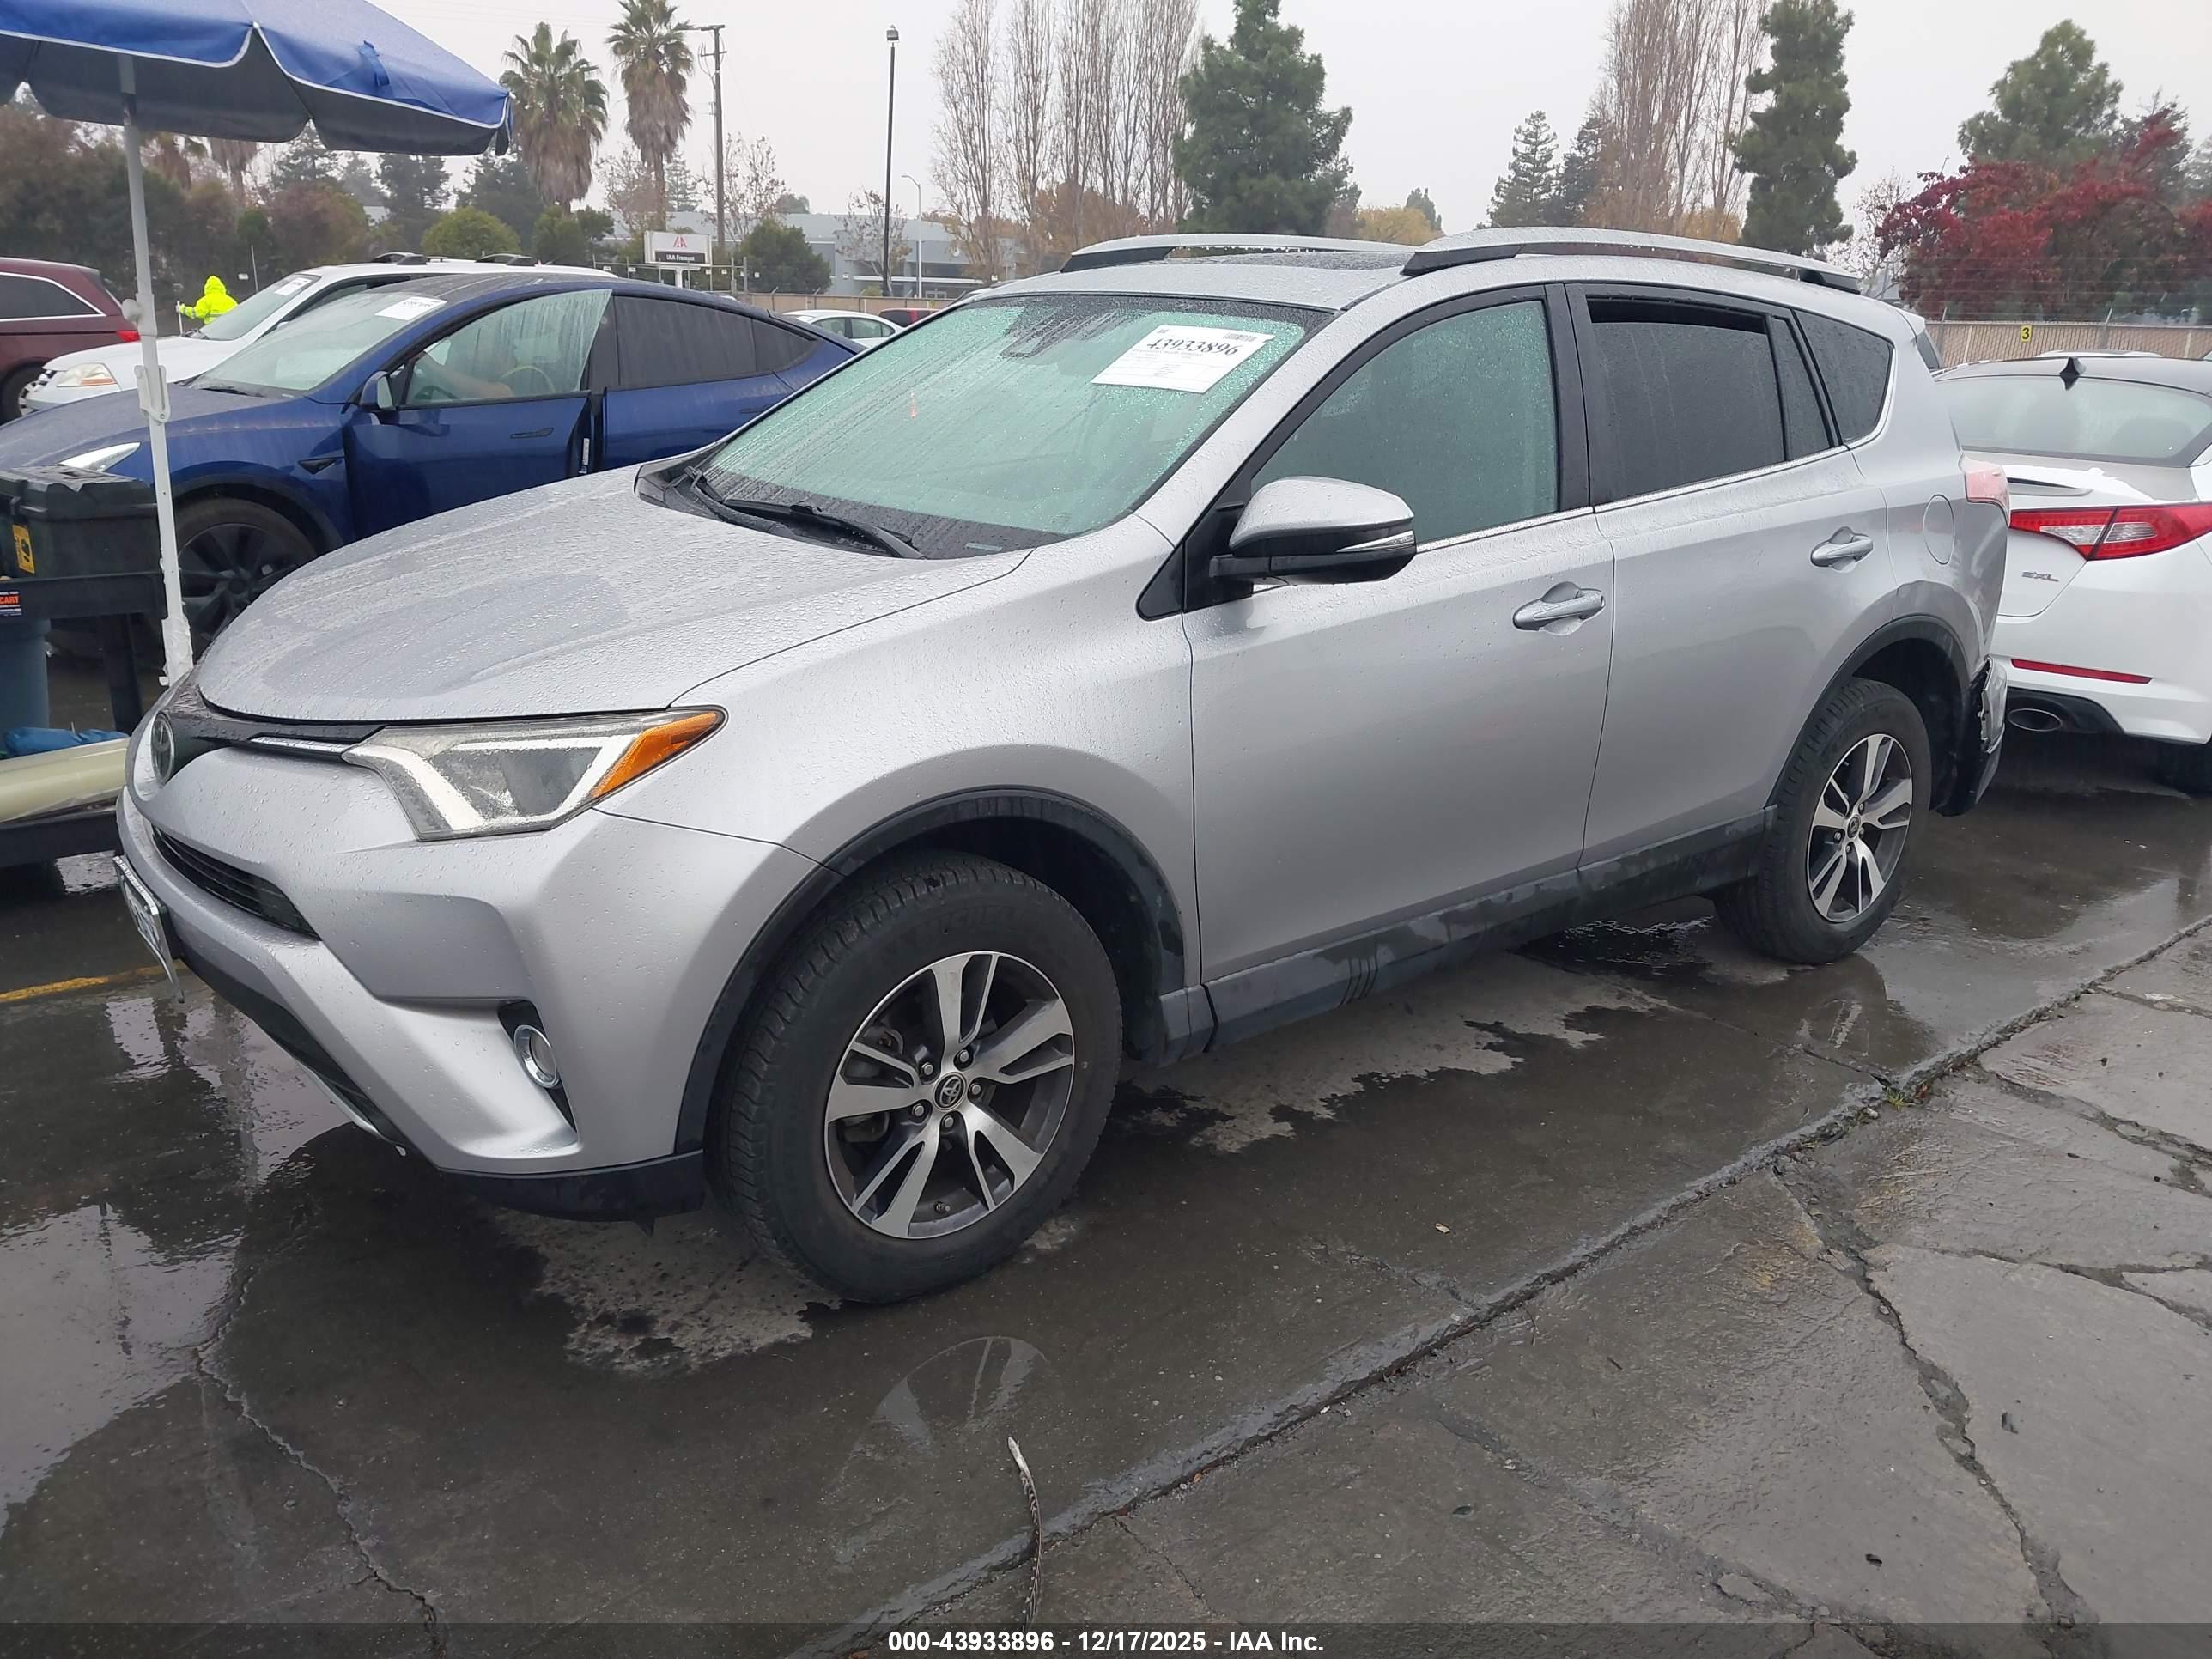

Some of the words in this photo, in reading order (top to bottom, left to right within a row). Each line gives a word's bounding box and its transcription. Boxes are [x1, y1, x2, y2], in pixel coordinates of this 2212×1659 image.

[2022, 327, 2030, 340] 3
[1146, 337, 1243, 356] 43933896
[0, 596, 19, 605] CART
